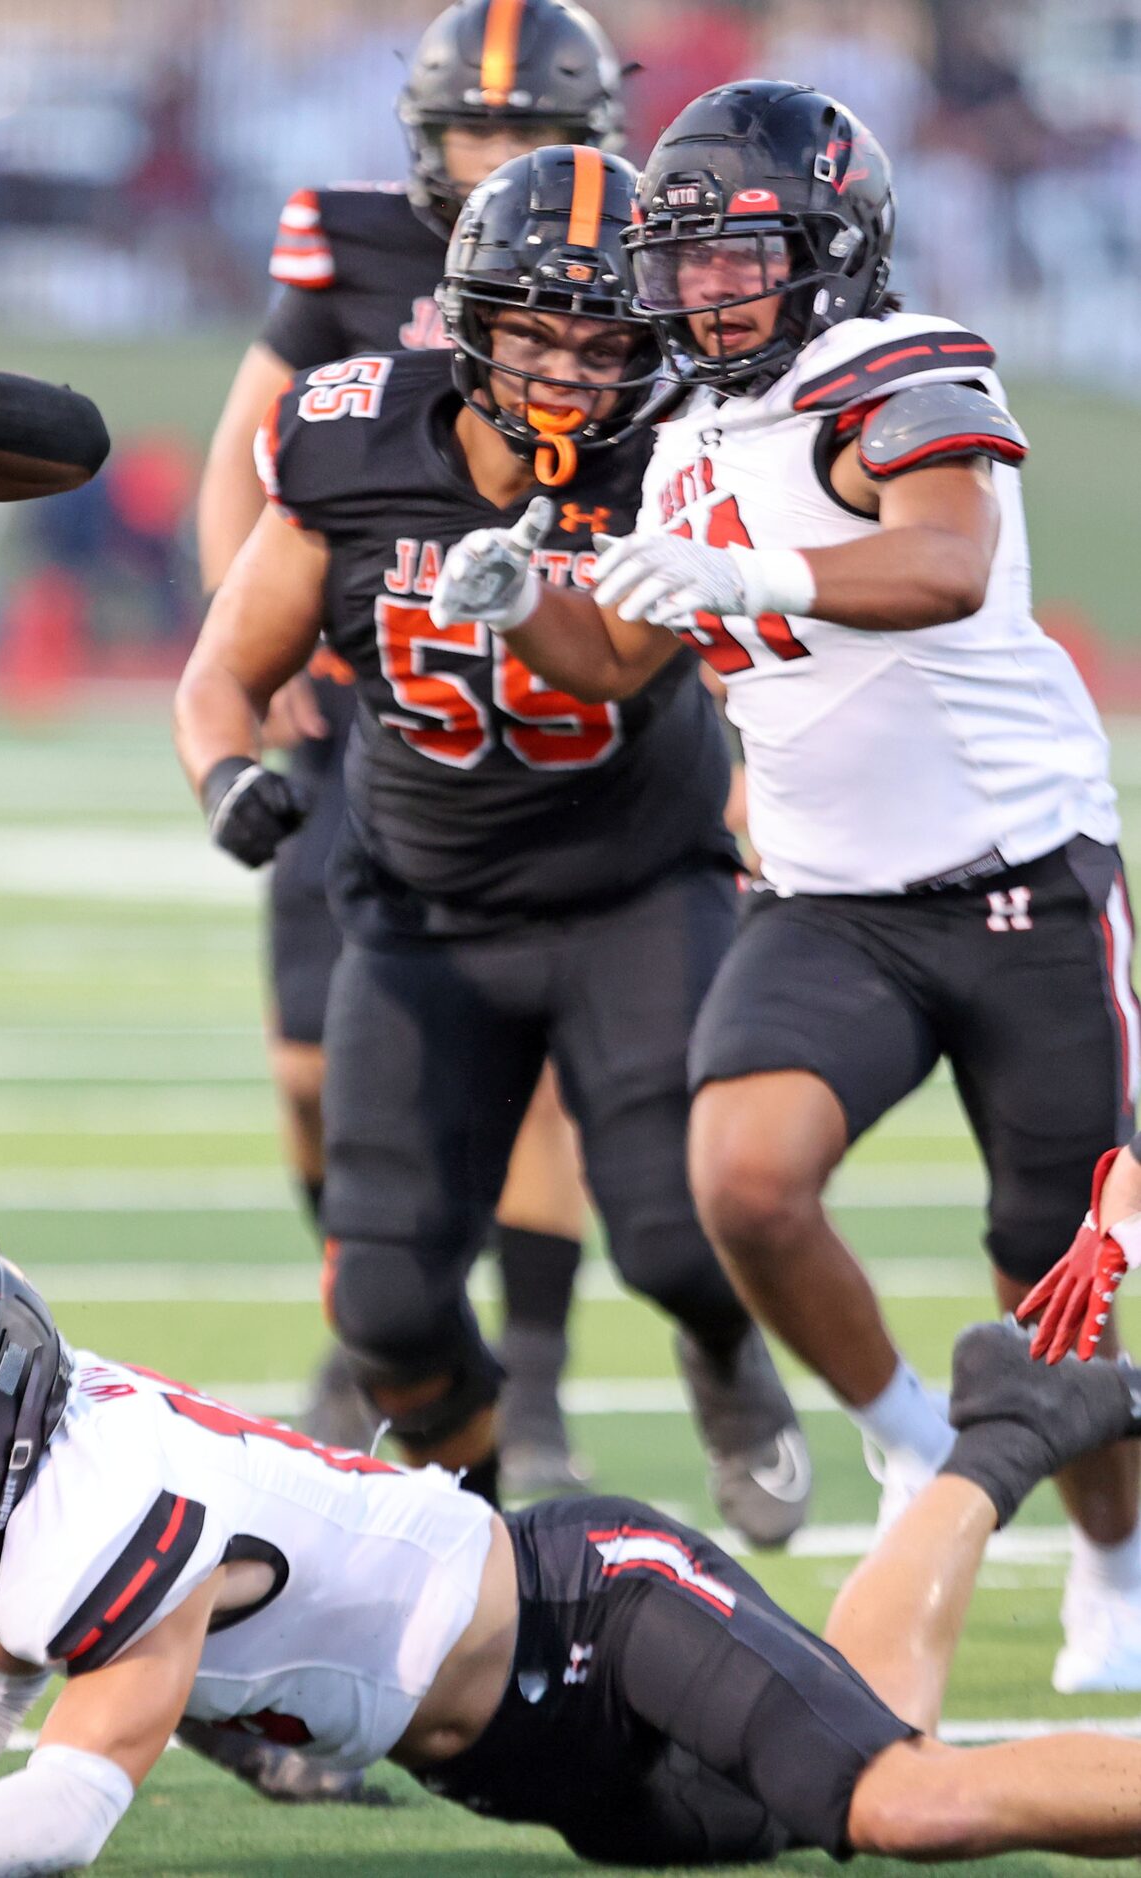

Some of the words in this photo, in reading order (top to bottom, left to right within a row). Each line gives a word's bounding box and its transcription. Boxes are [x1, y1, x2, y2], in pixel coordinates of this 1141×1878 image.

[297, 356, 395, 422] 55
[384, 537, 601, 594] JATS
[376, 595, 623, 771] 55
[986, 886, 1033, 932] H
